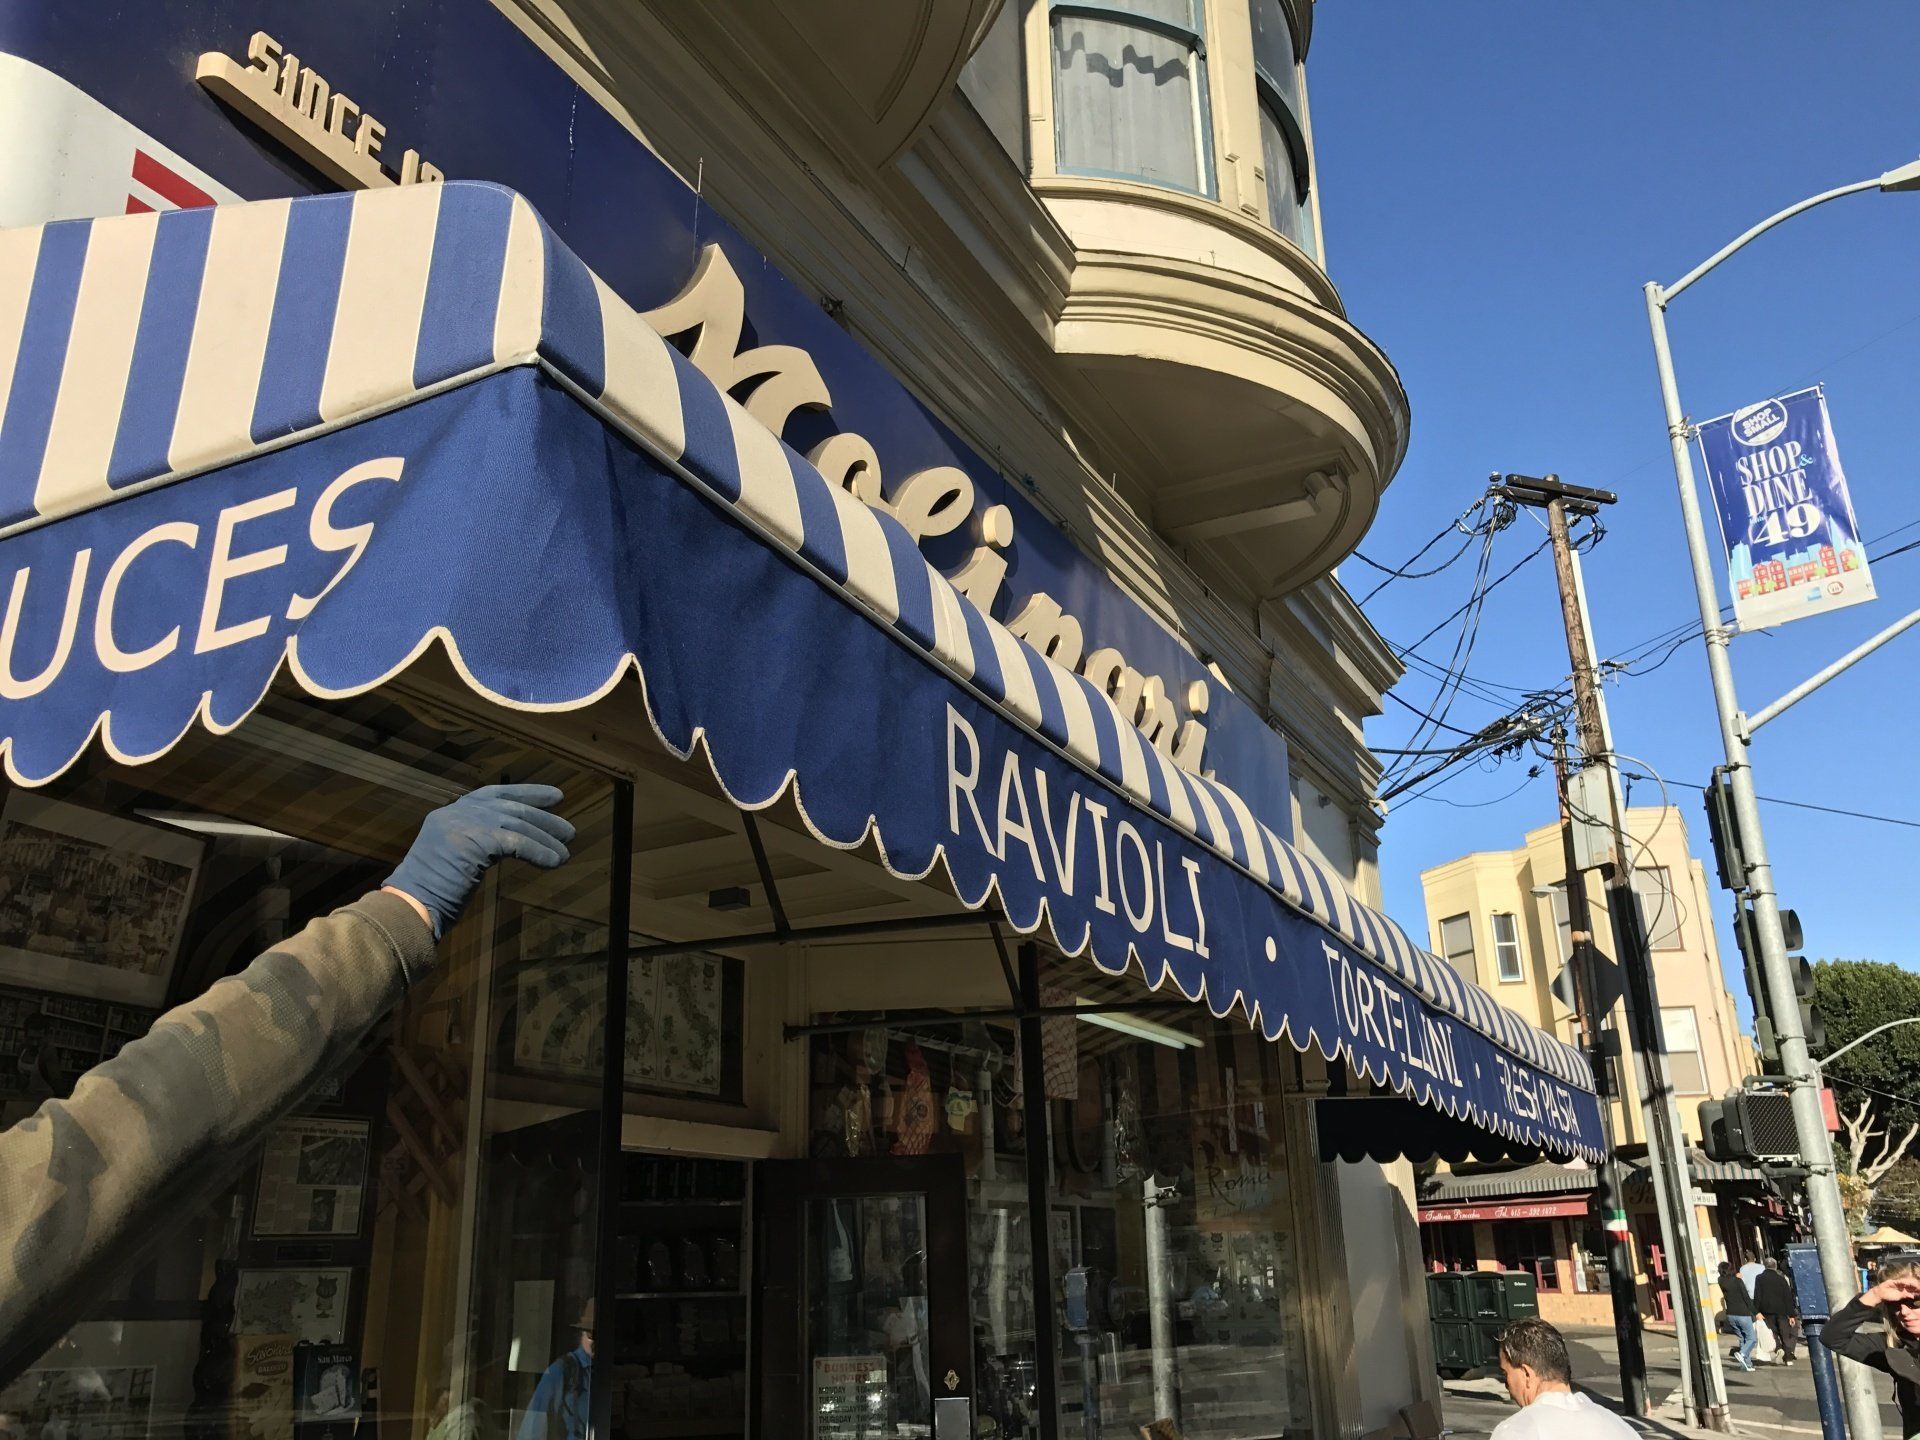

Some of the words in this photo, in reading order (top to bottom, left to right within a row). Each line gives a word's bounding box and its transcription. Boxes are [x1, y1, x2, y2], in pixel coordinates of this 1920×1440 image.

[246, 31, 387, 160] SINCE
[1742, 407, 1772, 430] SHOP
[1743, 413, 1780, 437] SMALL
[1736, 441, 1802, 486] SHOP
[1742, 469, 1813, 519] DINE
[1753, 503, 1821, 547] 49
[946, 702, 1209, 959] RAVIOLI
[1540, 1079, 1581, 1137] PASTA
